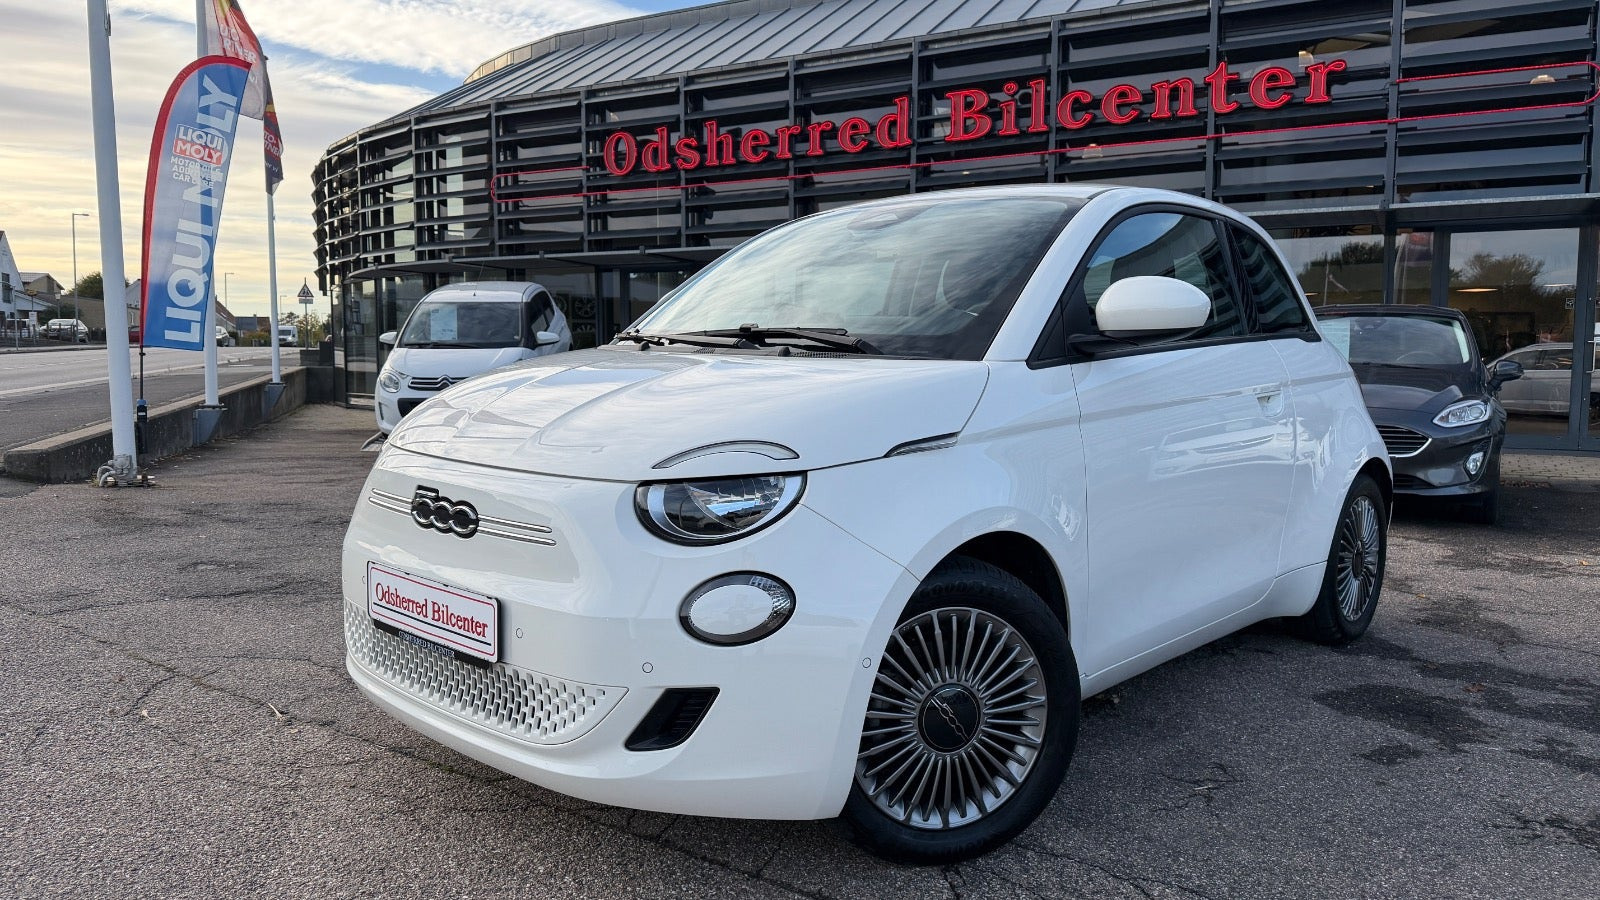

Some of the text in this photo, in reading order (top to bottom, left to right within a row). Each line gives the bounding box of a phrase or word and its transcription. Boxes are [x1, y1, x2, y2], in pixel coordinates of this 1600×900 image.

[178, 126, 223, 150] LIQUI
[603, 59, 1347, 176] Odsherred Bilcenter
[173, 172, 191, 182] CAR
[176, 141, 221, 163] MOLY
[164, 74, 238, 343] LIQUI MLY
[411, 484, 480, 539] 500
[375, 582, 488, 638] Odsherred Bilcenter
